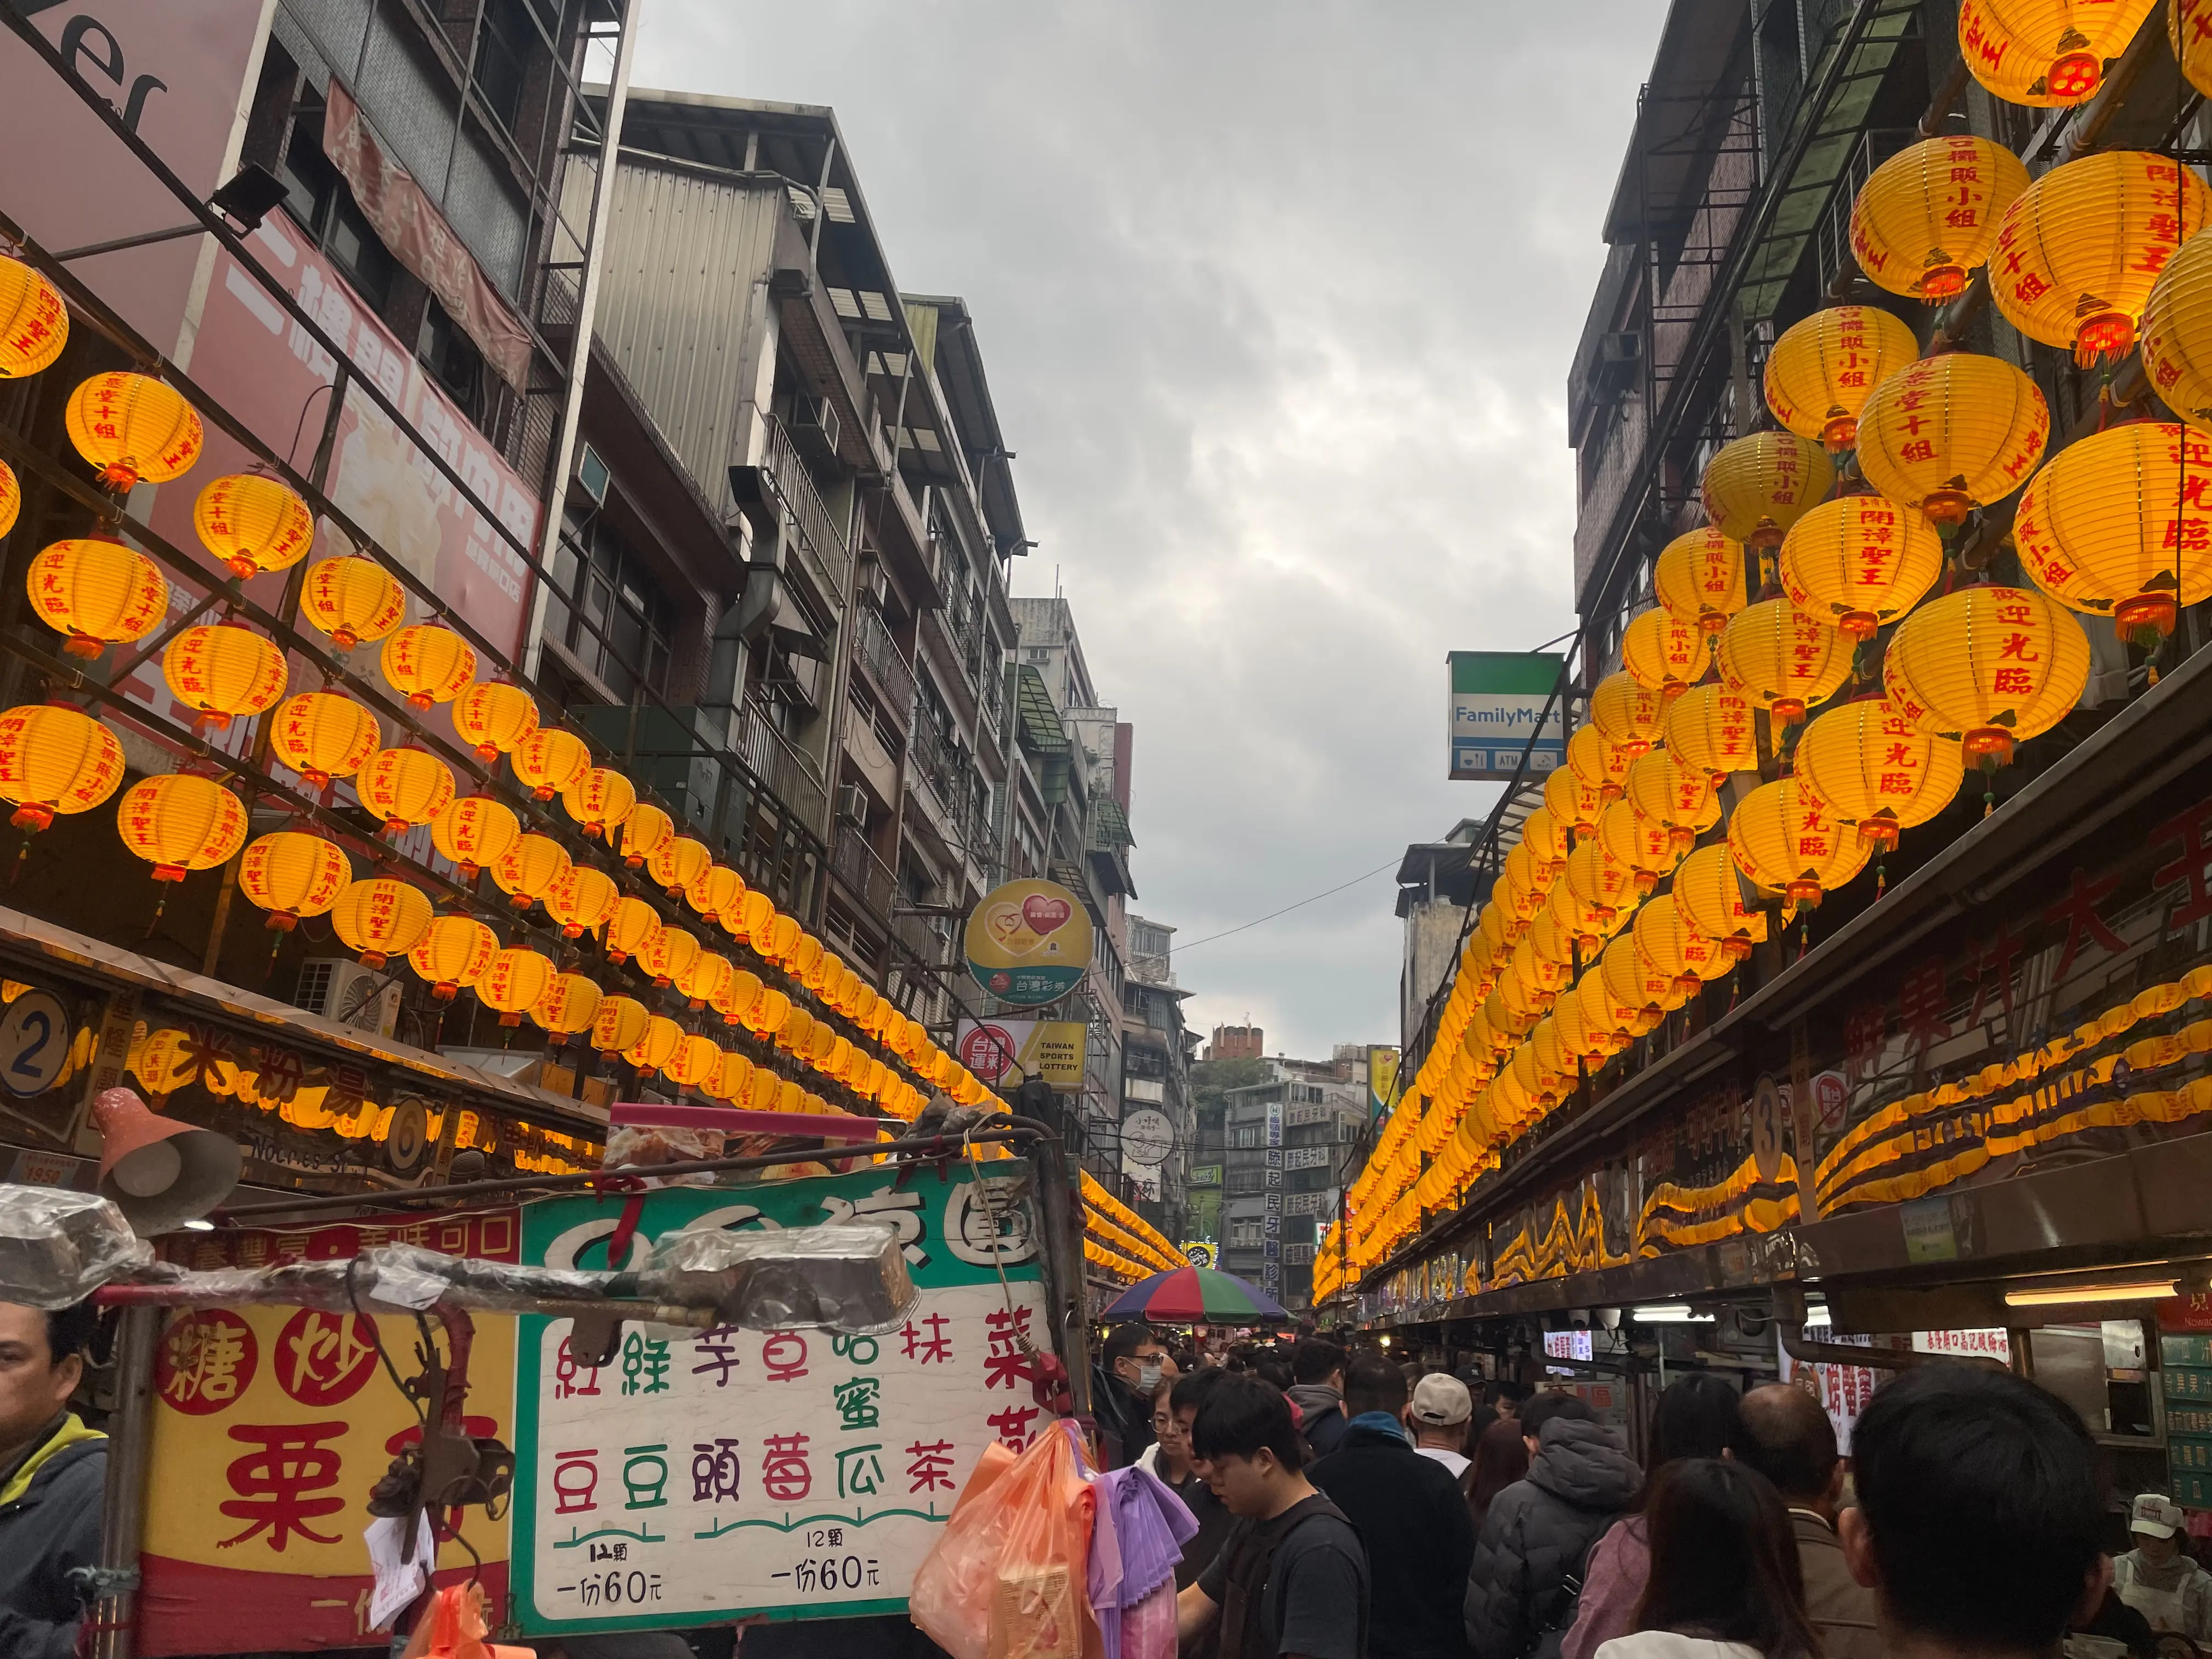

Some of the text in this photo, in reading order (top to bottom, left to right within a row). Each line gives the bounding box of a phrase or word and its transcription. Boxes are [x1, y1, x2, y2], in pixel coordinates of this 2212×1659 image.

[1836, 306, 1869, 387] 口攤販小組
[1770, 432, 1799, 505] 口攤販小組
[1703, 526, 1728, 592] 口攤販小組
[1854, 511, 1894, 585] 開漳聖王
[1991, 589, 2038, 695] 歡迎光臨
[1500, 755, 1518, 766] ATM
[1016, 980, 1066, 992] 台灣彩券
[11, 1011, 51, 1078] 2
[172, 1022, 367, 1120] 米粉湯
[398, 1115, 417, 1155] 6
[1759, 1093, 1775, 1153] 3
[555, 1334, 600, 1515] 紅豆
[622, 1330, 671, 1511] 綠豆
[691, 1324, 741, 1504] 芋頭
[761, 1327, 812, 1502] 草莓
[832, 1331, 885, 1500] 哈蜜瓜
[900, 1312, 956, 1494] 抹茶
[770, 1555, 881, 1592] 一份60元
[806, 1528, 844, 1549] 12顆
[556, 1570, 662, 1609] 一份60元
